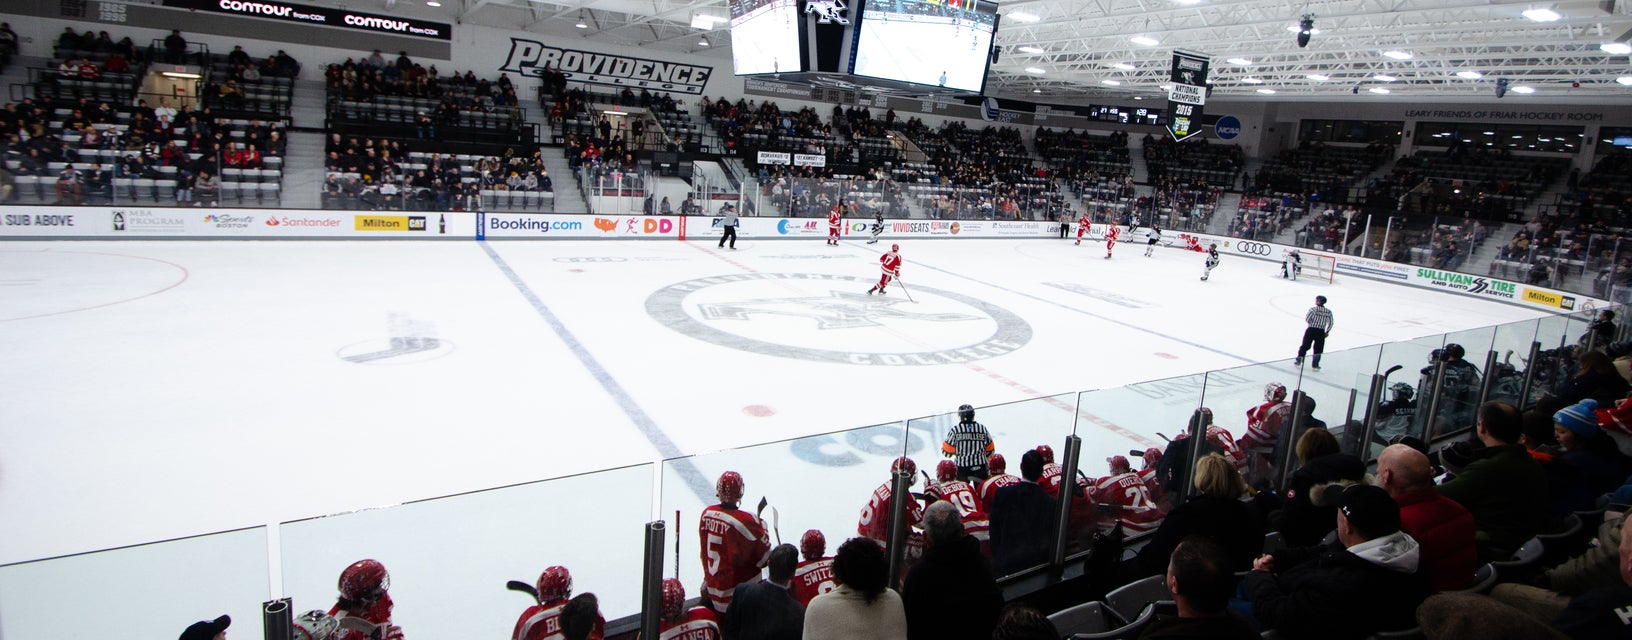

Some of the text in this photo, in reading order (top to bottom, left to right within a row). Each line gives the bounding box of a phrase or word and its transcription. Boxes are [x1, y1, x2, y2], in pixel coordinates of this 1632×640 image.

[503, 38, 711, 85] PROVIDENCE
[1175, 85, 1199, 95] NATIONAL
[1172, 92, 1201, 103] CHAMPIONS
[1176, 104, 1193, 116] 2015
[1405, 109, 1603, 121] LEARY FRIENDS OF FRIAR HOCKEY ROOM
[5, 214, 74, 226] SUB ABOVE
[130, 217, 184, 225] PROGRAM
[282, 216, 341, 227] Santander
[363, 219, 425, 228] Milton CAT
[490, 217, 582, 233] Booking.com
[1417, 268, 1473, 285] SULLIVAN
[1491, 280, 1516, 293] TIRE
[1485, 289, 1514, 299] SERVICE
[1528, 291, 1556, 303] Milton
[701, 516, 731, 536] CROTTY
[707, 534, 722, 577] 5
[804, 567, 833, 587] SWITZ
